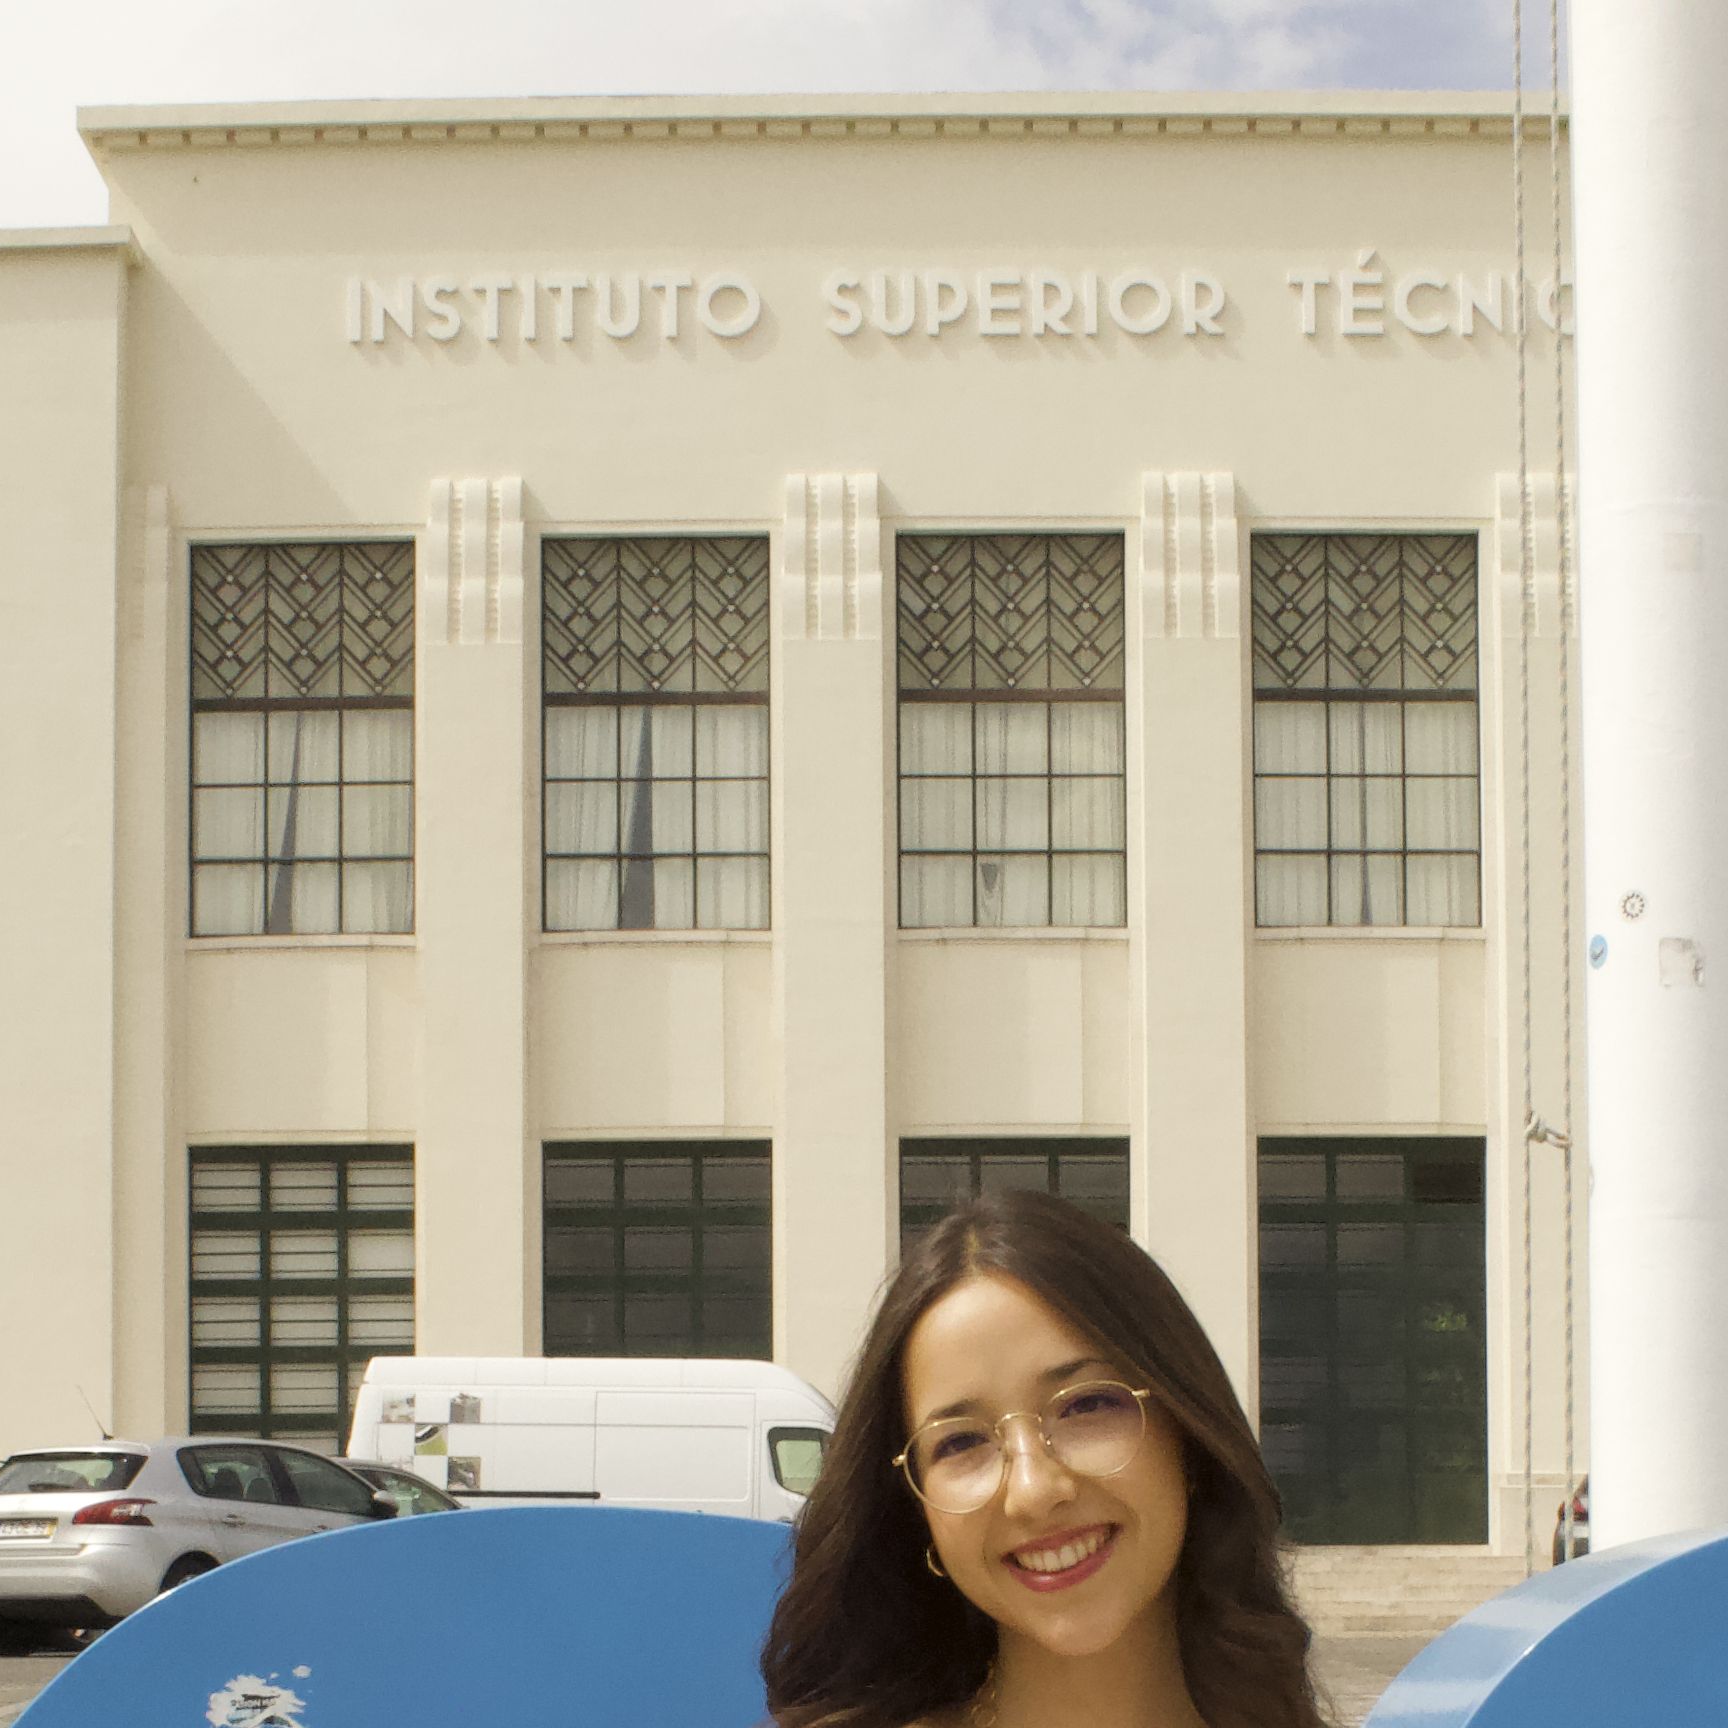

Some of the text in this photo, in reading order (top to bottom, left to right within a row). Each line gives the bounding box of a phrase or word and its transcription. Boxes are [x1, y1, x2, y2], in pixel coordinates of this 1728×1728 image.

[346, 248, 1574, 344] INSTITUTO SUPERIOR TÉCNIC
